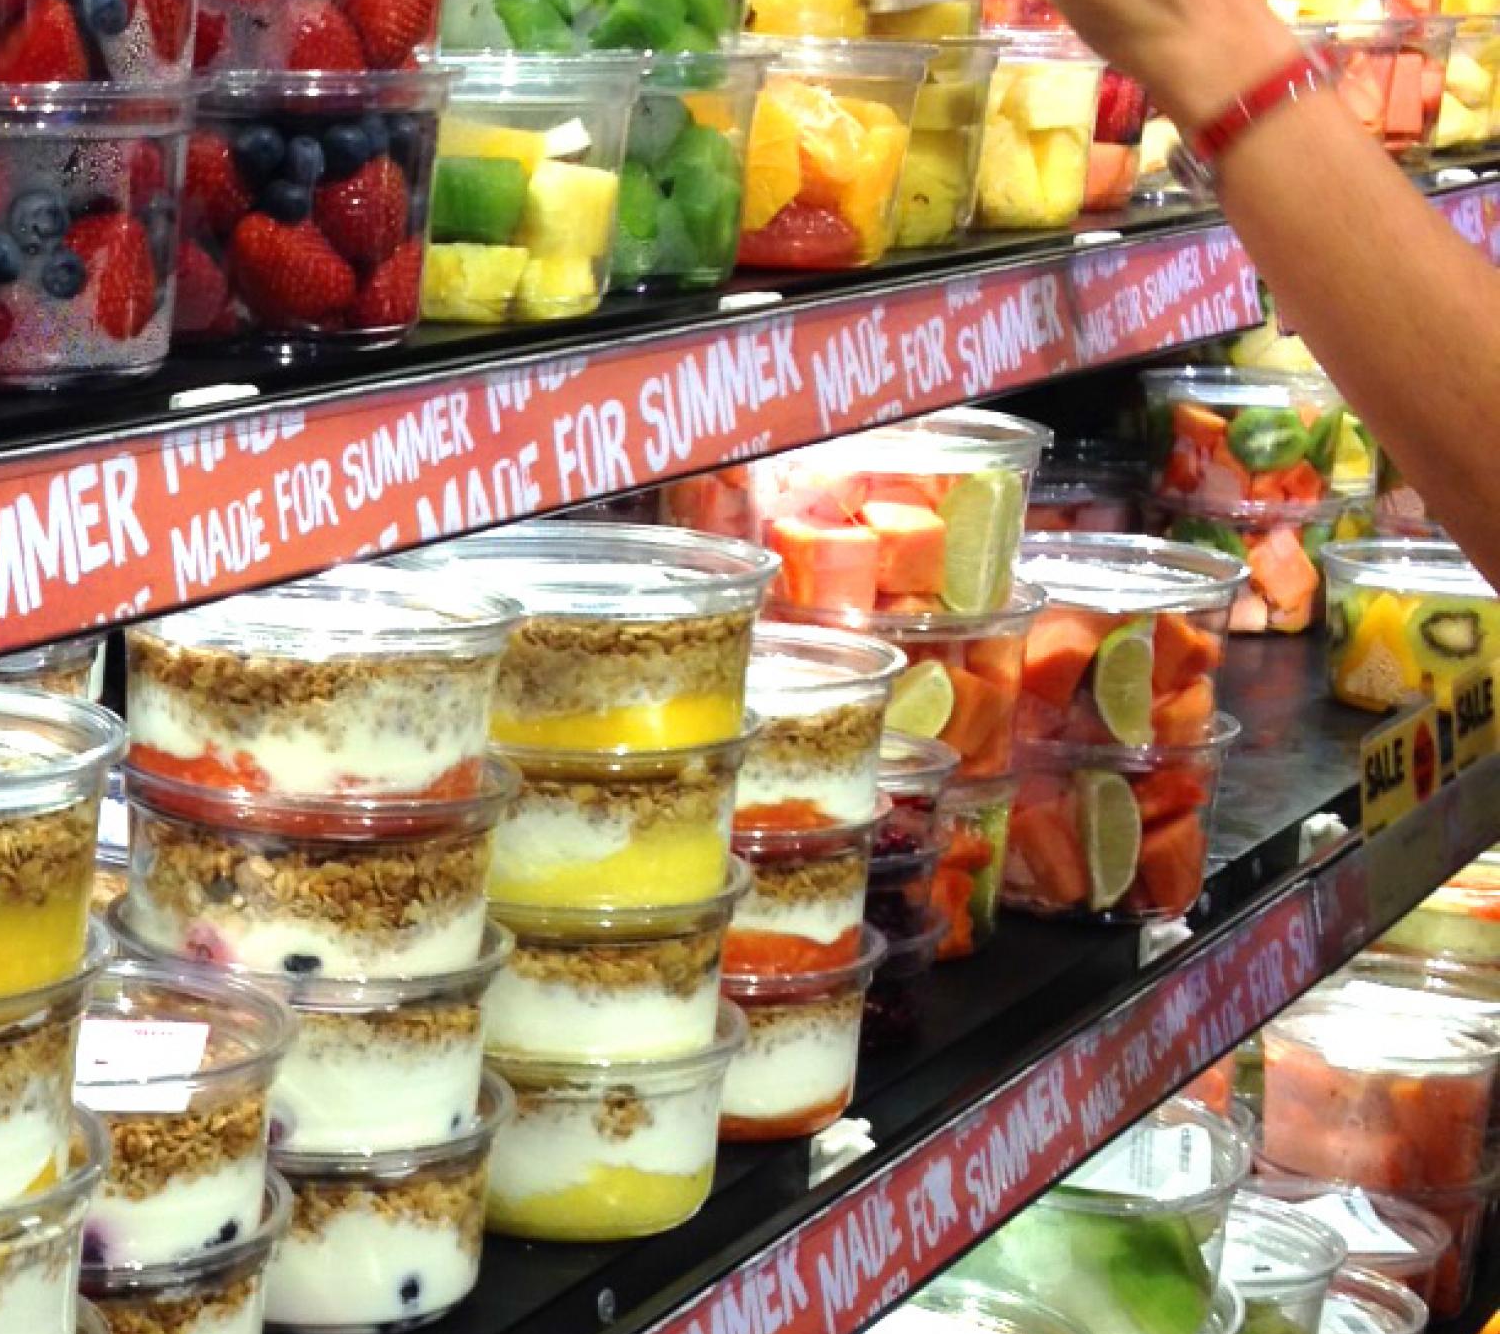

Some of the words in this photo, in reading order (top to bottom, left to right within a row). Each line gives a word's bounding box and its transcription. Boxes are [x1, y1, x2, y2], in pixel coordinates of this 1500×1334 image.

[553, 398, 637, 504] FOR
[639, 315, 803, 473] SUMMER
[812, 305, 895, 435] MADE
[901, 316, 951, 401] FOR
[957, 273, 1065, 397] SUMMER
[171, 490, 271, 602] MADE
[274, 458, 339, 542] FOR
[342, 388, 475, 511] SUMMER
[1366, 737, 1405, 804] SALE
[906, 1156, 959, 1261] FOR
[965, 1057, 1072, 1236] SUMMER
